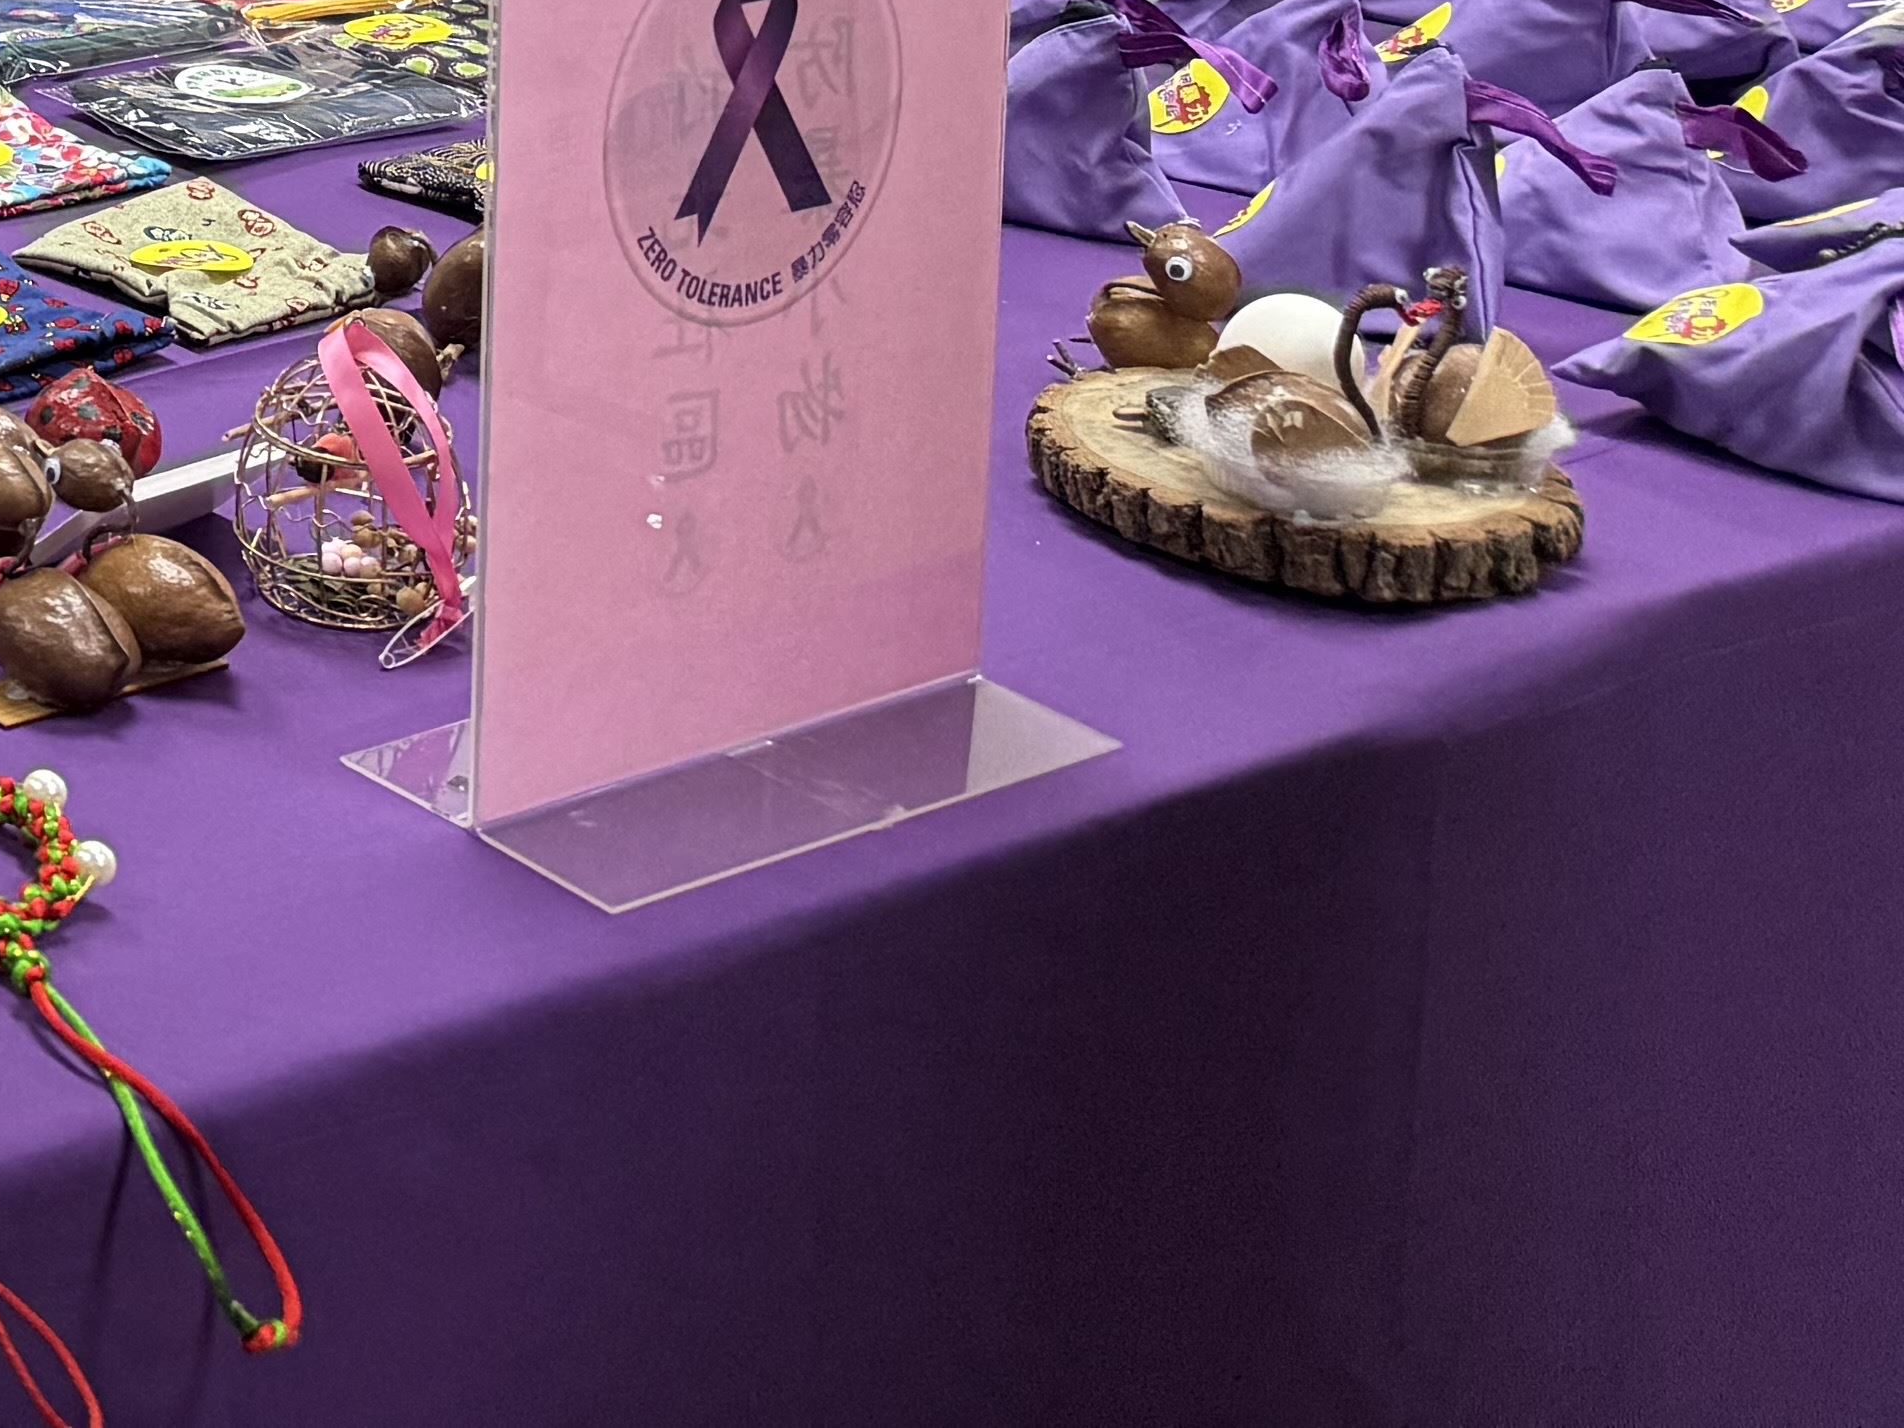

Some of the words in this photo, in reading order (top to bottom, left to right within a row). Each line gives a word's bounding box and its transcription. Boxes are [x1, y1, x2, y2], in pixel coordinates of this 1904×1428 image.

[636, 226, 678, 282] ZERO
[676, 268, 784, 309] TOLERANCE
[791, 180, 867, 284] 暴力零容忍
